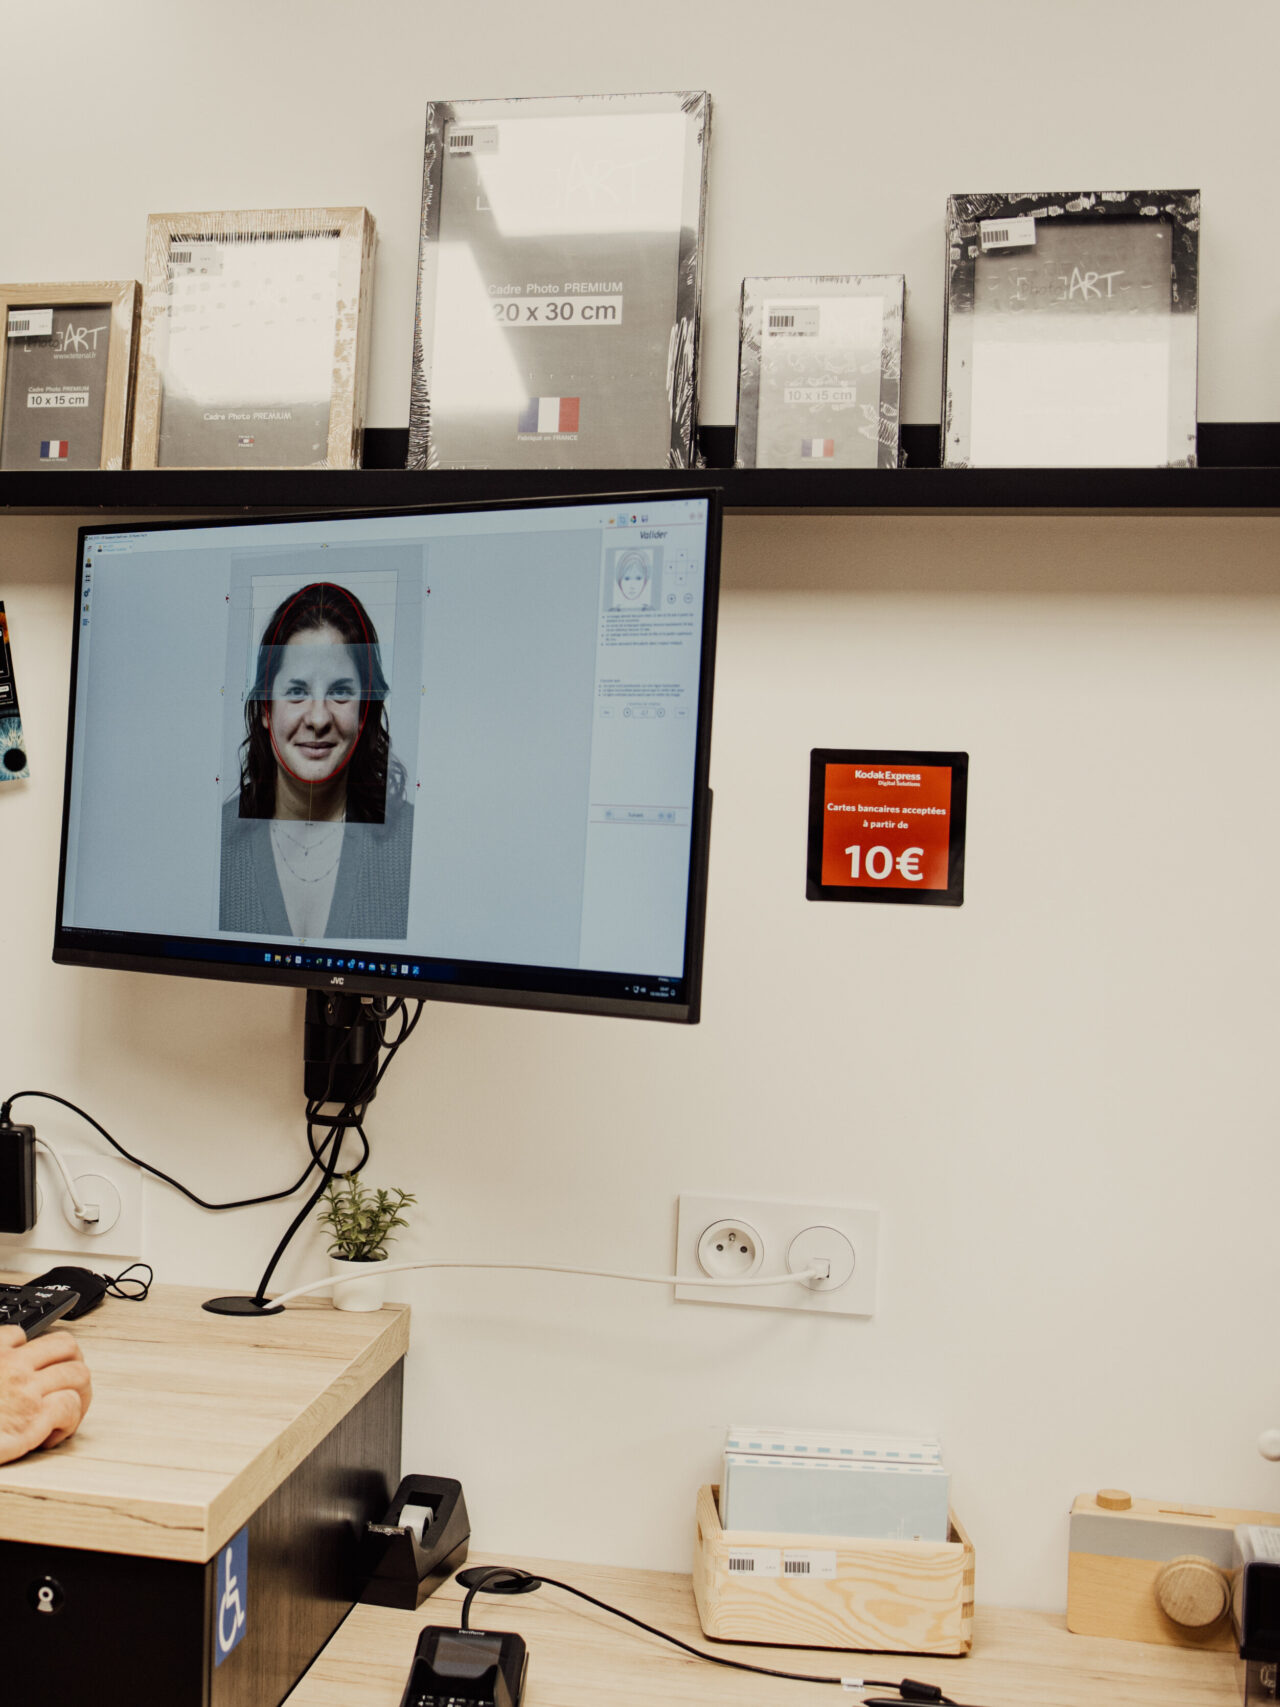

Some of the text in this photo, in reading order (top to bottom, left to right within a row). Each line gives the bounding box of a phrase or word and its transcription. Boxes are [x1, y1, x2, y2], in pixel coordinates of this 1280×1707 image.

[488, 281, 623, 295] Cadre Photo PREMIUM
[1070, 266, 1124, 300] ART
[492, 302, 617, 322] 20 x 30 cm
[64, 323, 107, 352] ART
[31, 396, 85, 405] 10 x 15 cm
[788, 391, 801, 400] 10
[805, 392, 813, 400] x
[832, 391, 852, 400] cm
[203, 411, 292, 420] Cadre Photo PREMIUM
[640, 530, 668, 539] Valider
[855, 769, 921, 782] Kodak Express
[827, 803, 946, 816] Cartes bancaires acceptées
[863, 820, 909, 829] à partir de
[845, 845, 924, 881] 10€
[330, 977, 345, 985] JVC
